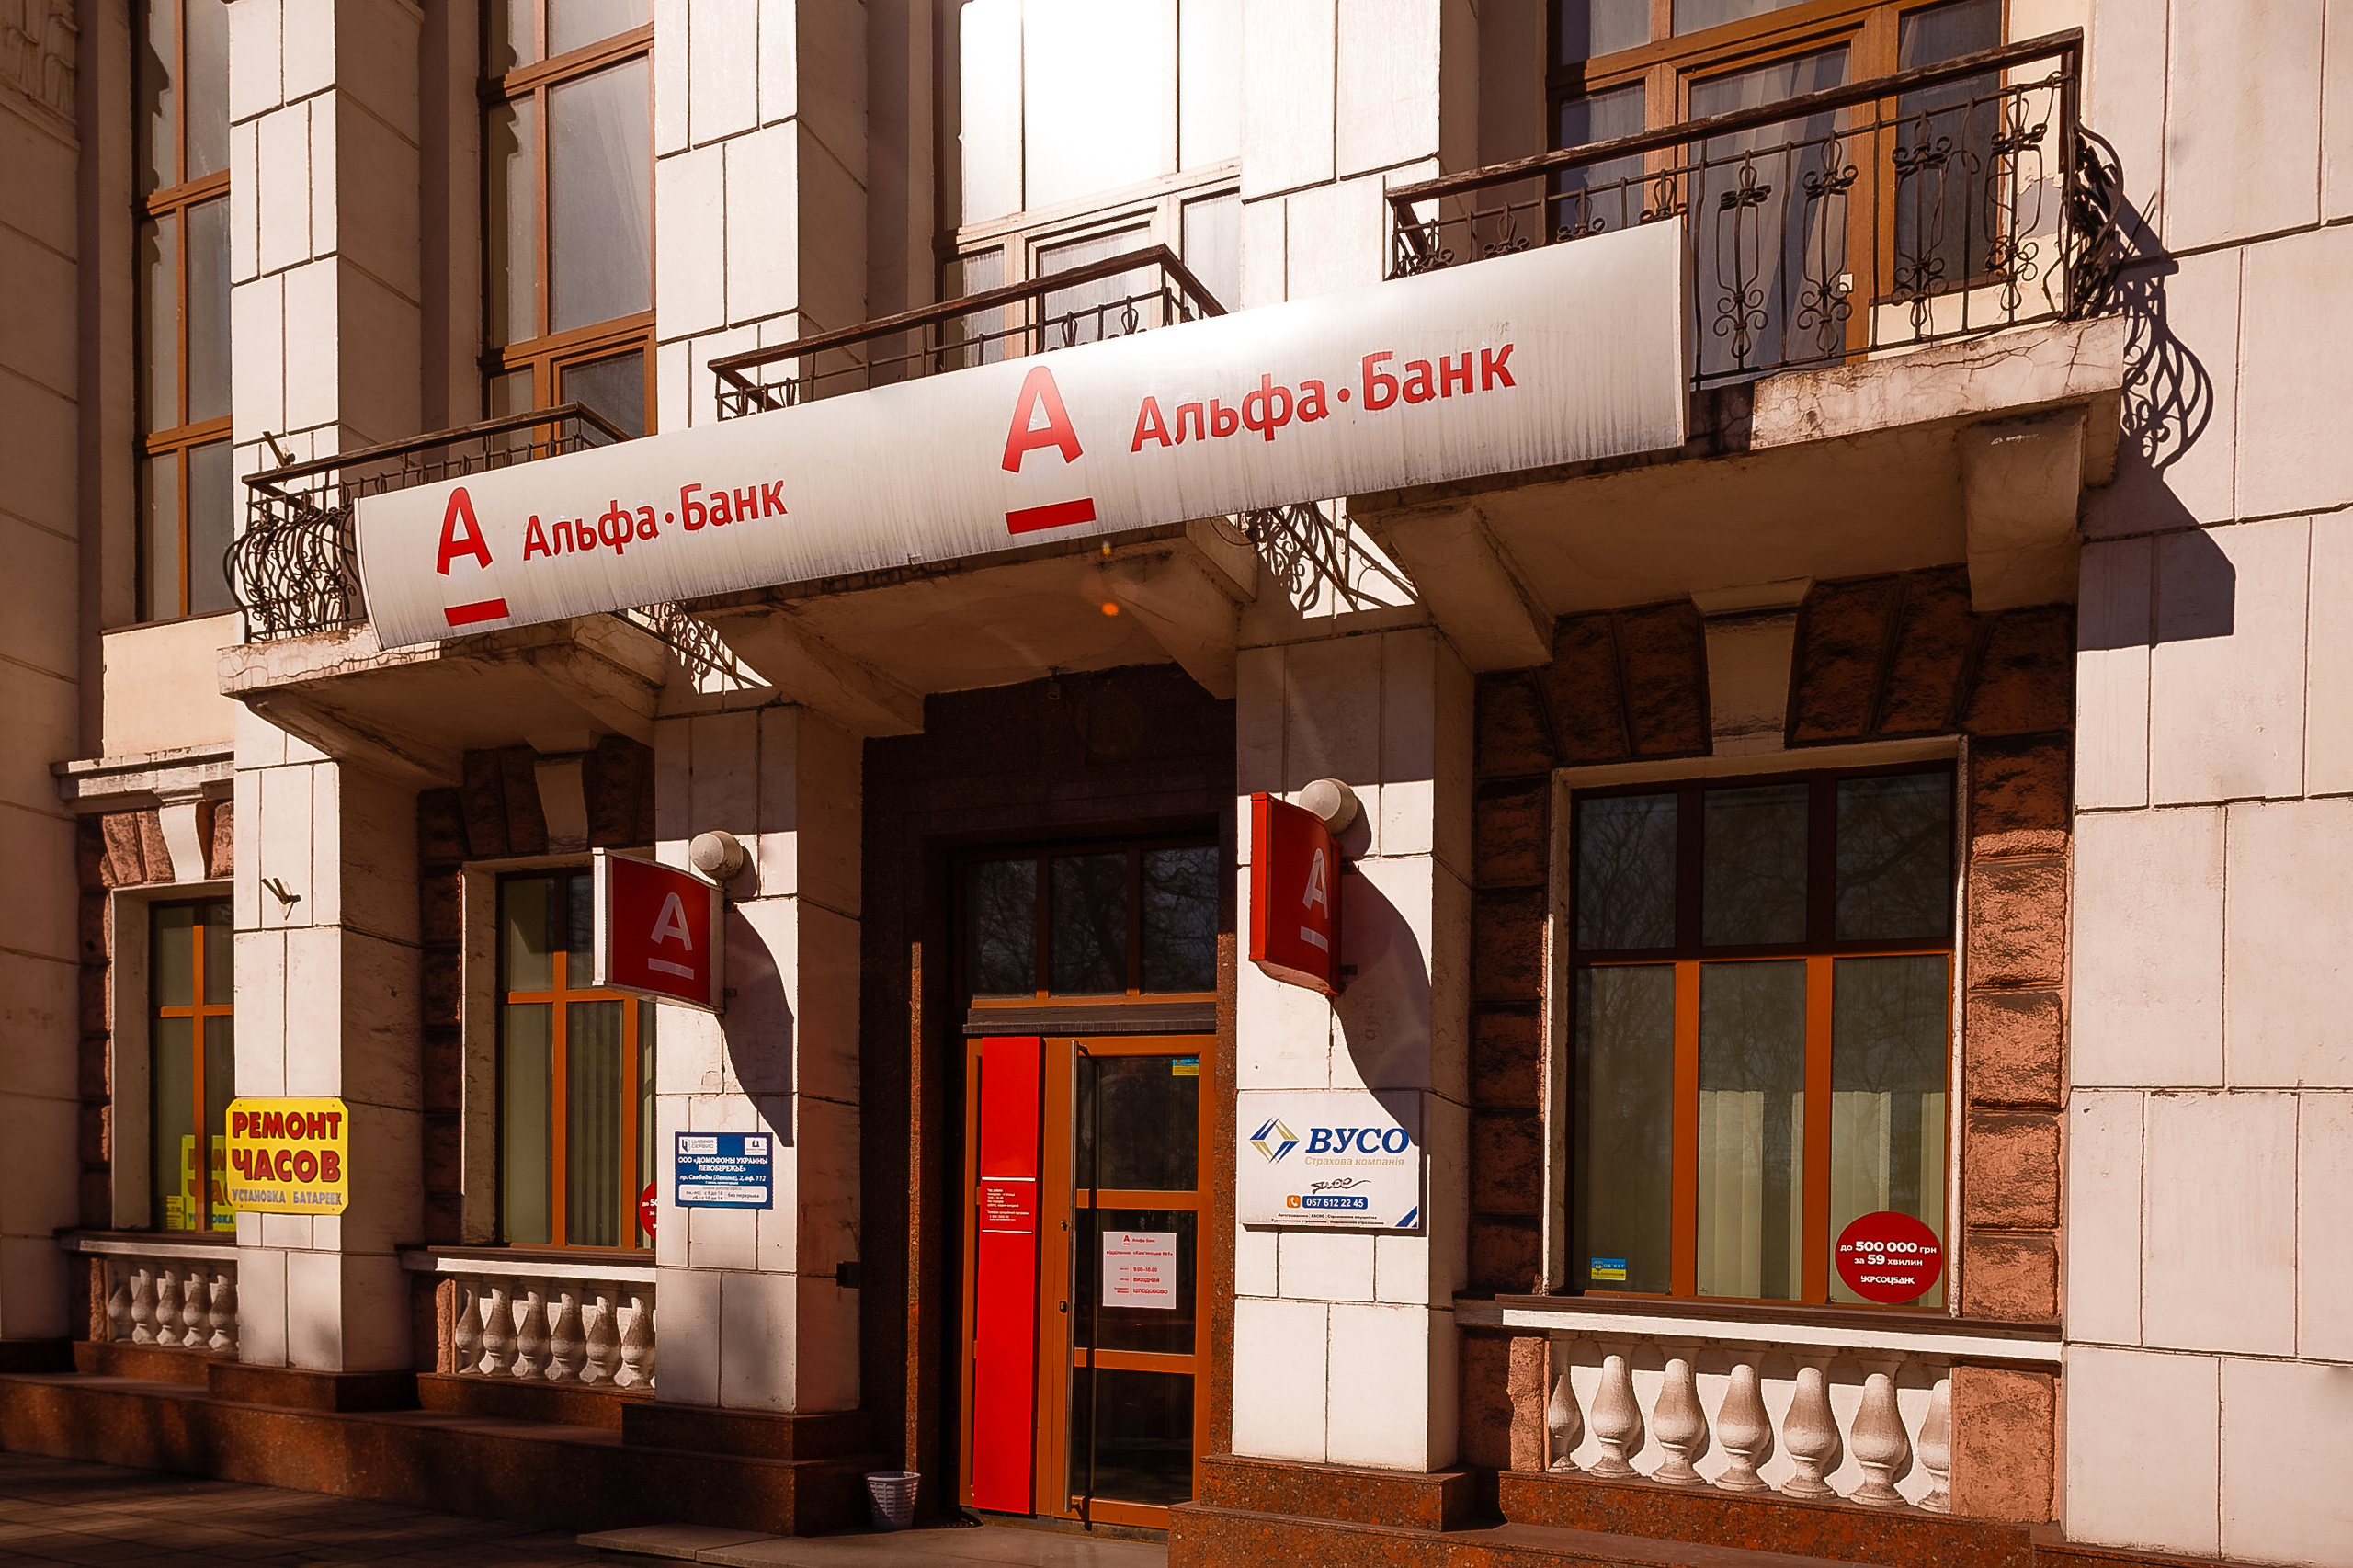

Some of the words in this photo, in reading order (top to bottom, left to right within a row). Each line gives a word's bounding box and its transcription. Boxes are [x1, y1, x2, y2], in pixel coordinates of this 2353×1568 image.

[233, 1111, 342, 1140] РЕМОНТ
[1305, 1127, 1410, 1154] ВУСО
[232, 1149, 341, 1183] ЧАСОВ
[1305, 1156, 1353, 1167] Страхова
[1355, 1157, 1404, 1166] компанія
[232, 1189, 286, 1203] УСТАНОВКА
[293, 1191, 342, 1205] БАТАРЕЕК
[1306, 1198, 1321, 1207] 067
[1324, 1198, 1339, 1207] 612
[1340, 1199, 1351, 1207] 22
[1353, 1199, 1364, 1207] 45
[1855, 1241, 1884, 1252] 500
[1886, 1242, 1918, 1253] 000
[1867, 1254, 1885, 1265] 59
[1860, 1275, 1915, 1285] УКРСОЦБАНК
